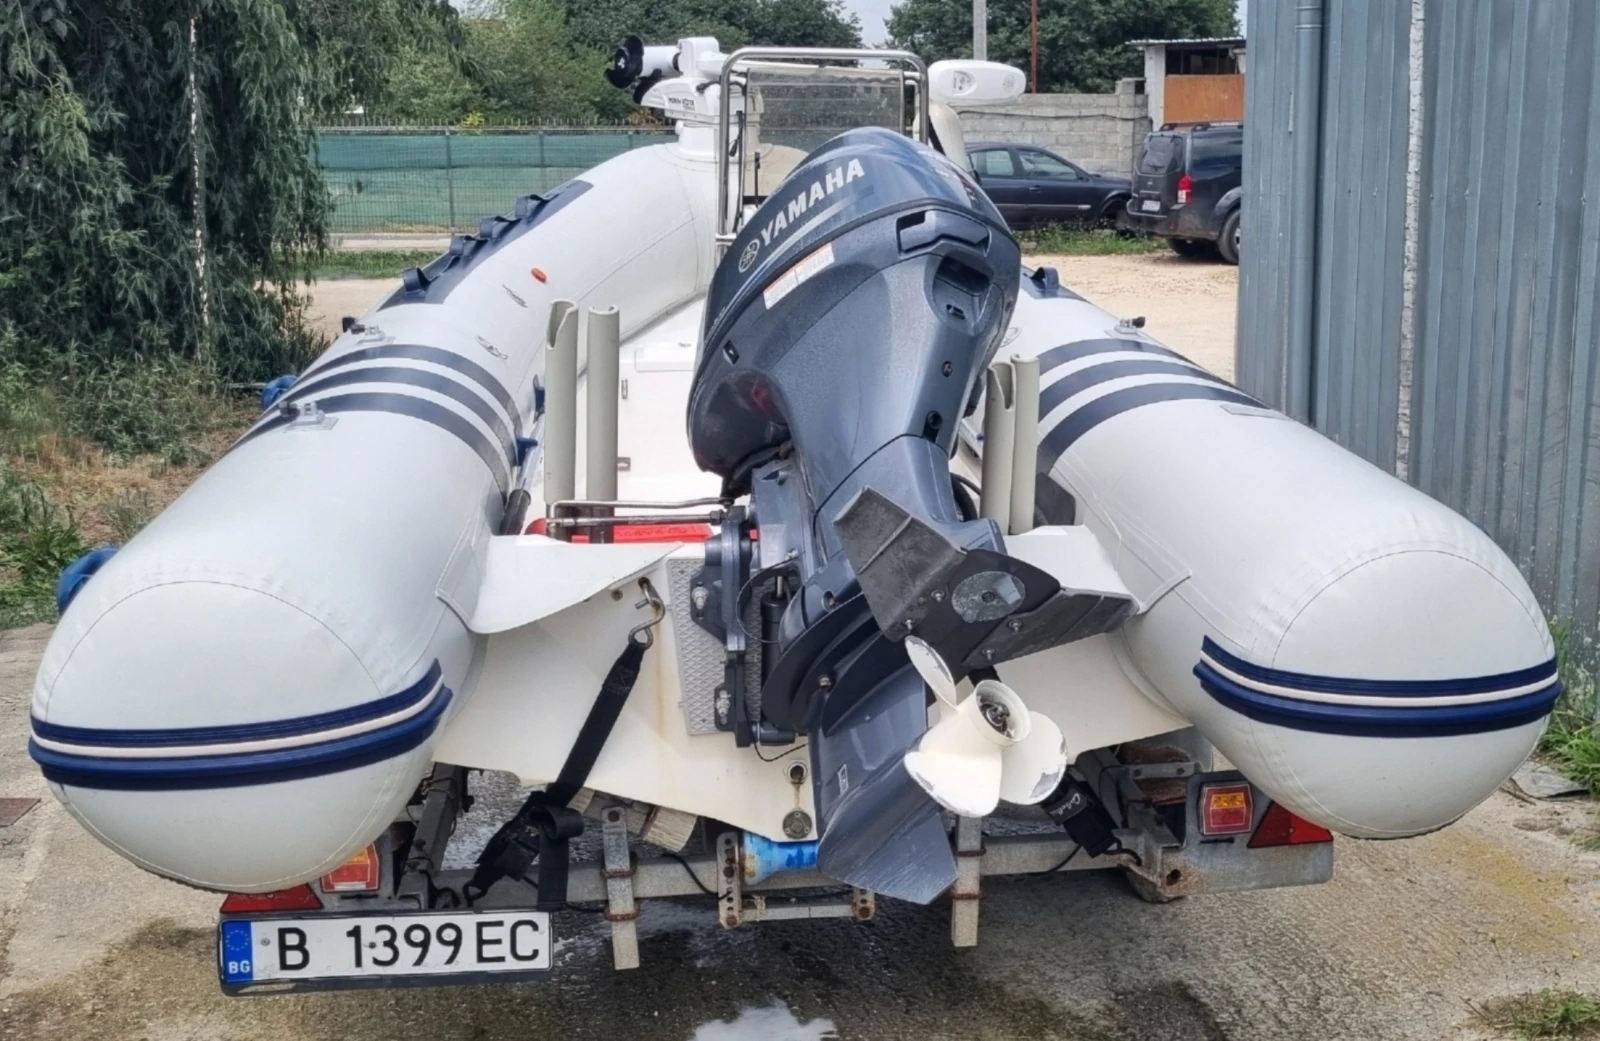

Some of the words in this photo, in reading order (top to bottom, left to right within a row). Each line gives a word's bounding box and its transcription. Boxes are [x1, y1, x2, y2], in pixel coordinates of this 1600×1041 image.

[761, 158, 865, 247] YAMAHA
[228, 961, 251, 975] BG
[277, 927, 310, 971] B
[346, 923, 463, 969] 1399
[475, 919, 540, 964] EC
